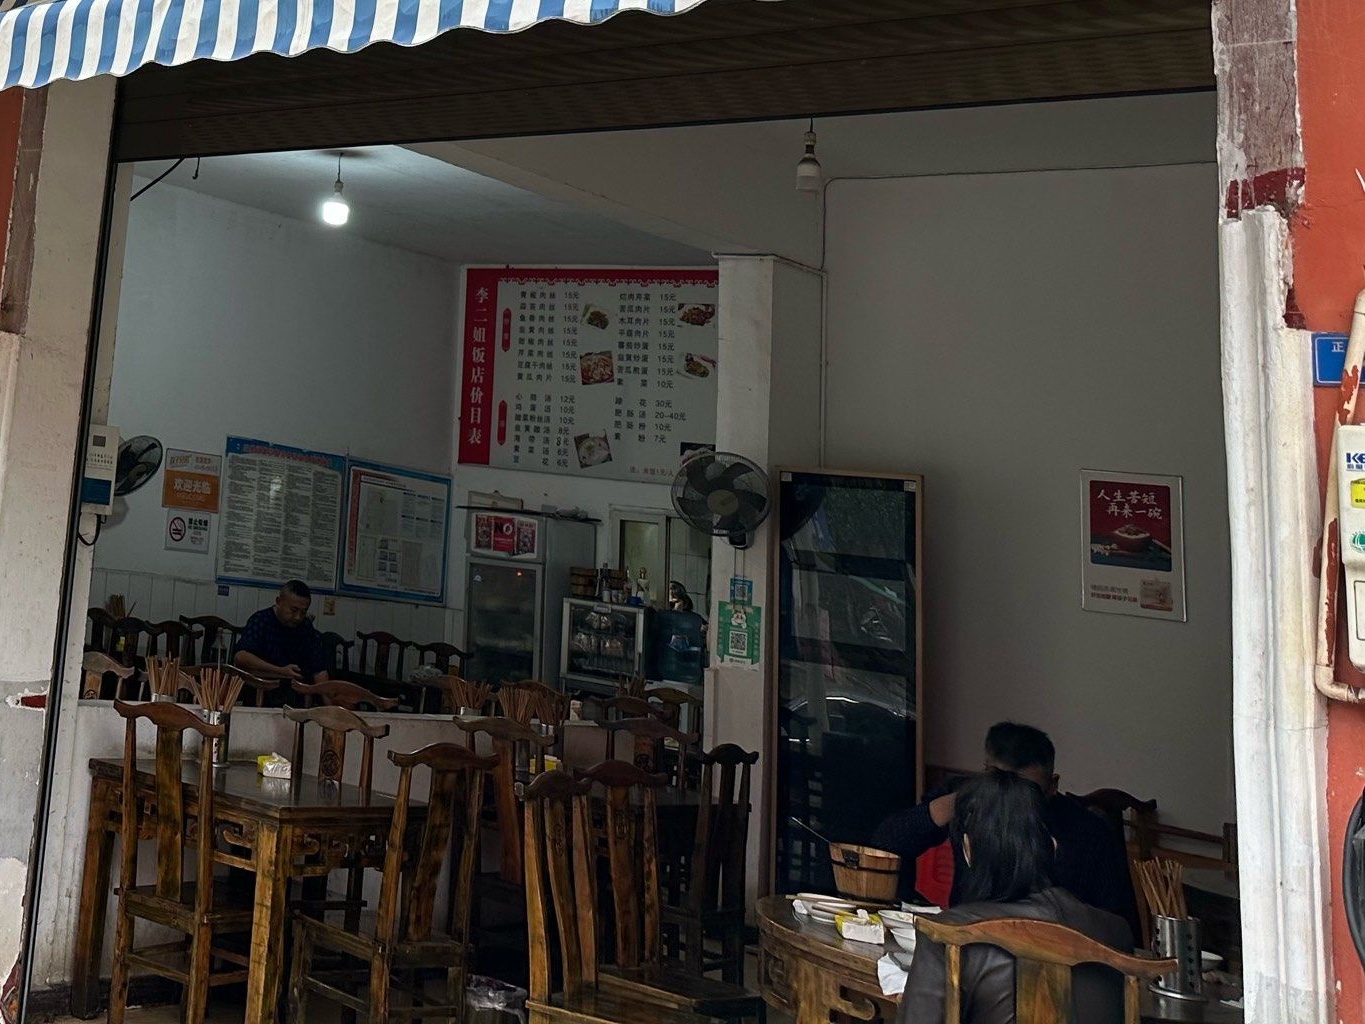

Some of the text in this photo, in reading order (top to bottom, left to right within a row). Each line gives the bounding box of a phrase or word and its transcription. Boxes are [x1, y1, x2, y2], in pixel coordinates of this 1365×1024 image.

[564, 291, 580, 300] 15元
[660, 293, 677, 301] 15元
[659, 306, 676, 314] 15元
[564, 315, 579, 323] 15元
[659, 318, 676, 326] 15元
[563, 326, 579, 335] 15元
[658, 330, 675, 338] 15元
[562, 338, 578, 347] 15元
[658, 343, 675, 351] 15元
[1331, 341, 1345, 353] 正
[562, 351, 577, 359] 15元
[657, 355, 675, 364] 15元
[467, 286, 489, 445] 李二姐饭店价目表
[561, 362, 576, 371] 15元
[657, 368, 674, 376] 15元
[561, 375, 576, 383] 15元
[657, 380, 674, 388] 10元
[560, 395, 575, 404] 12元
[655, 400, 673, 408] 30元
[560, 406, 575, 414] 10元
[559, 417, 575, 425] 10元
[654, 423, 672, 432] 10元
[653, 435, 666, 444] 7元
[173, 478, 212, 495] 欢迎光临
[1097, 489, 1157, 505] 人生苦短
[1106, 502, 1162, 520] 再来一碗
